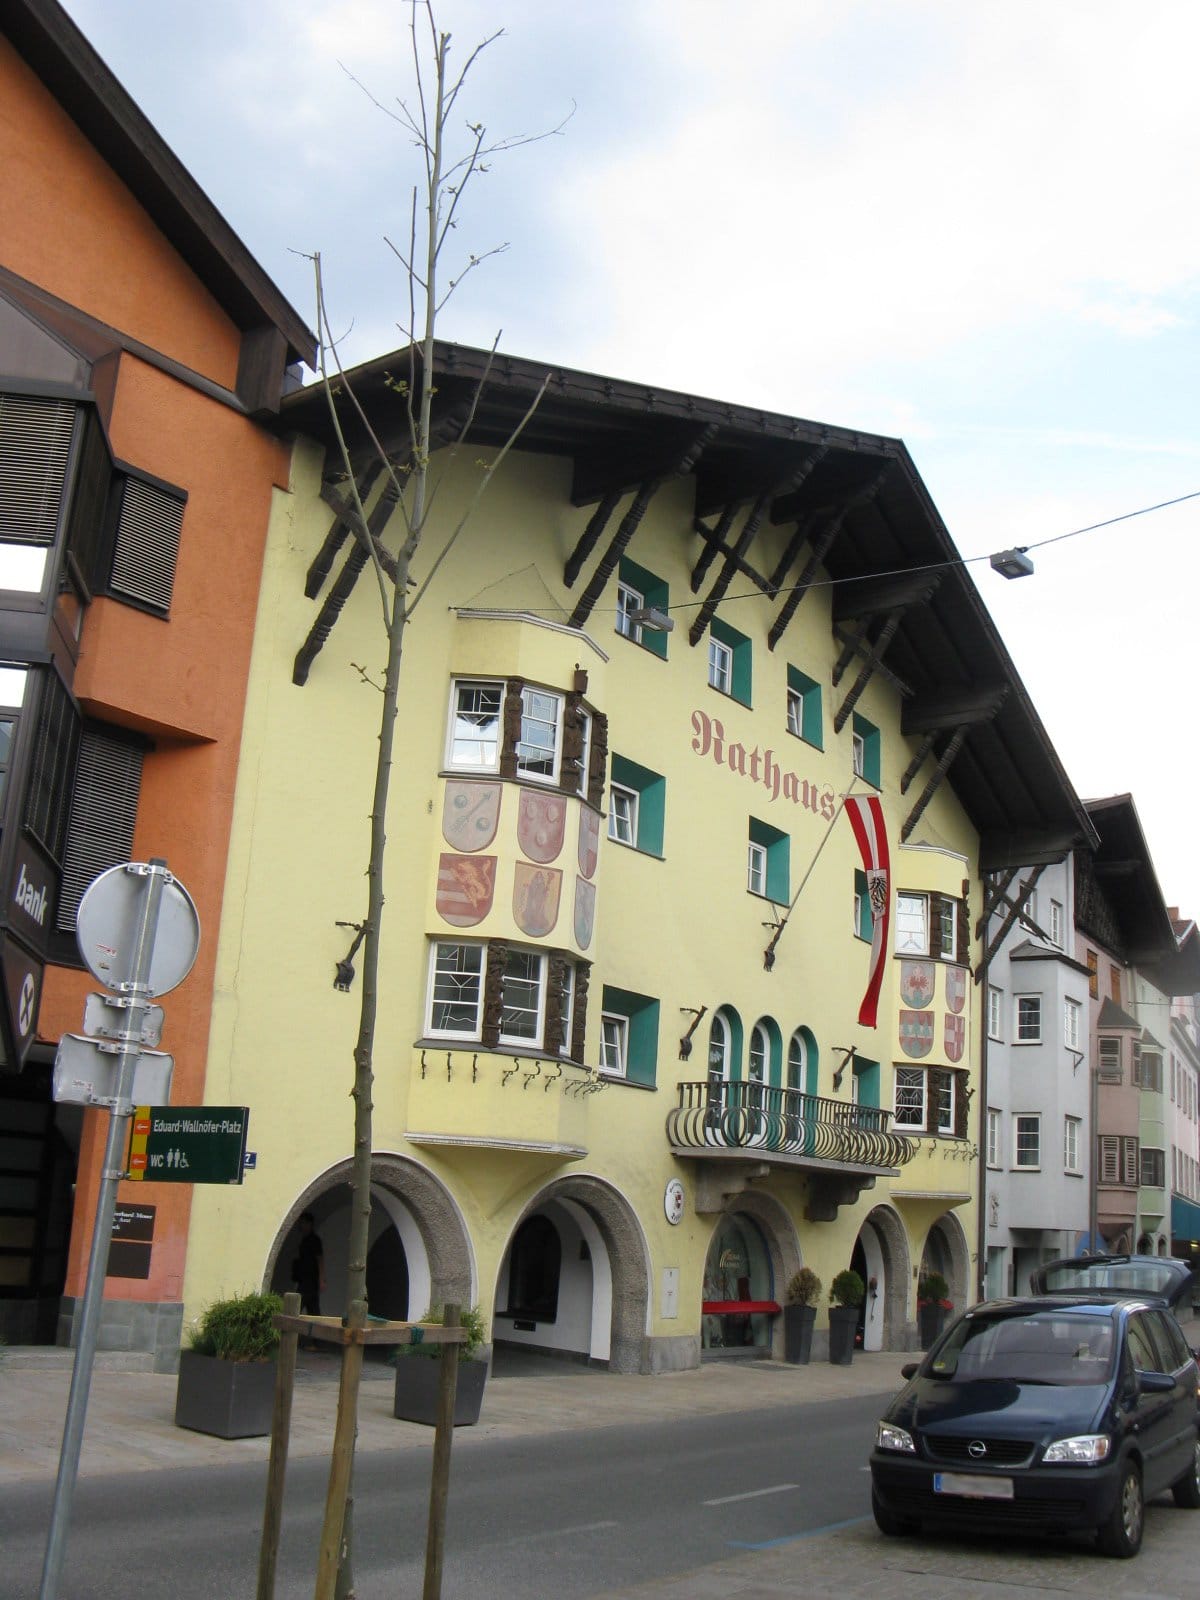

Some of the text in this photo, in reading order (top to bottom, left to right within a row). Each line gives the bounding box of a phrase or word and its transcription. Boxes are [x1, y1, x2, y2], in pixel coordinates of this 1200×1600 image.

[691, 710, 835, 821] Rathaus
[15, 863, 47, 926] bank
[153, 1119, 241, 1133] Eduard-Wallnöfer-Platz
[150, 1154, 164, 1168] WC
